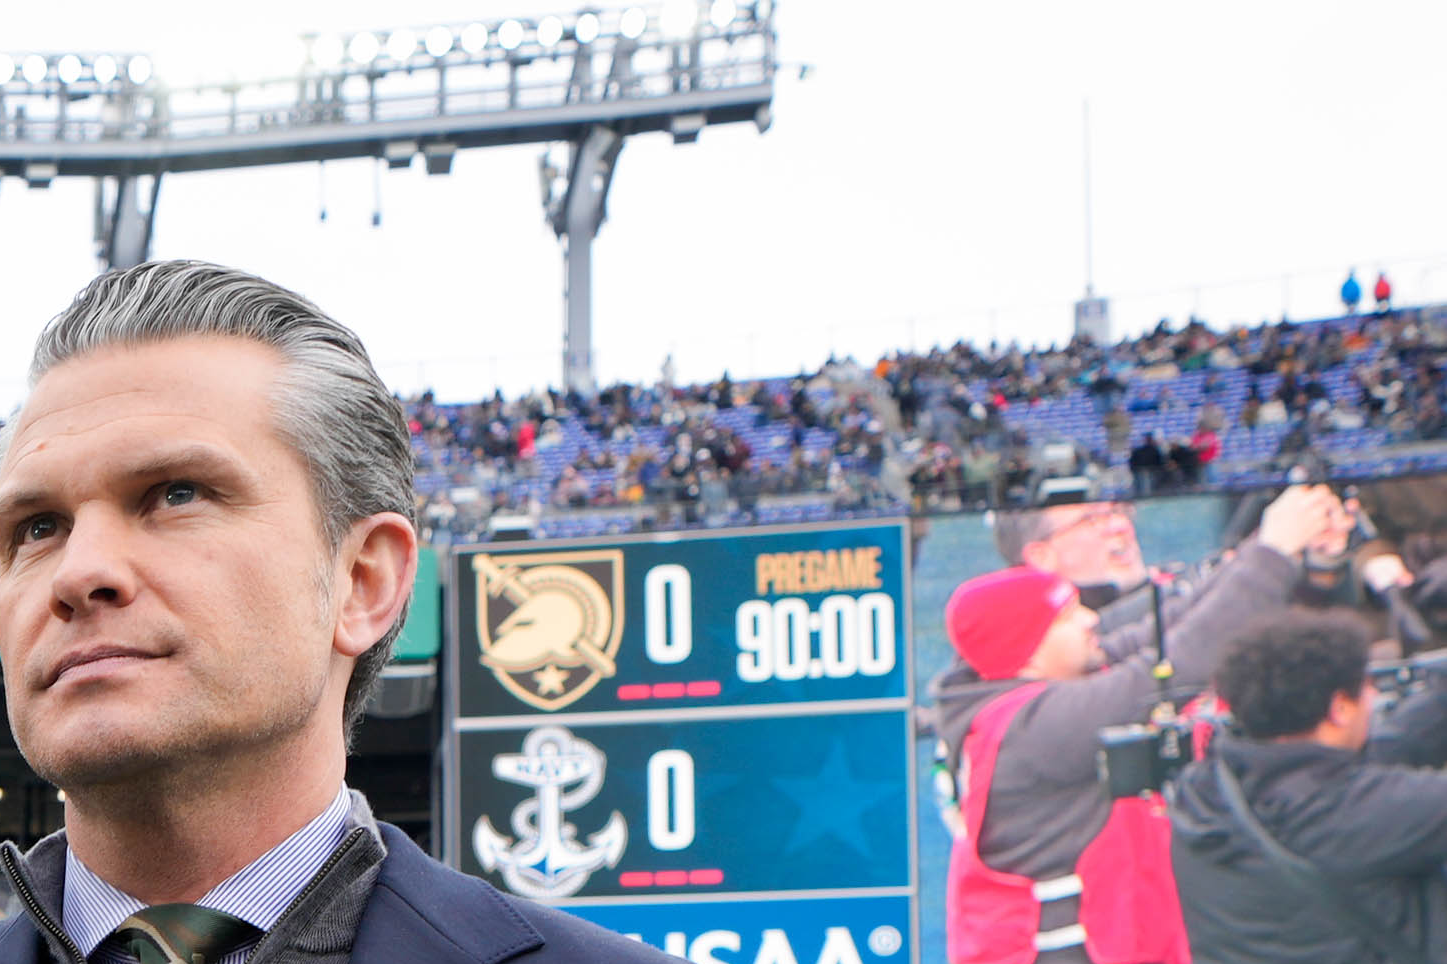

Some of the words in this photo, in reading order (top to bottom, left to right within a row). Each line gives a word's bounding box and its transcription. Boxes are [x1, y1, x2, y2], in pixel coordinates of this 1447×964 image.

[644, 564, 692, 663] 0
[756, 547, 881, 597] PREGAME
[736, 592, 896, 682] 90:00
[647, 749, 695, 851] 0
